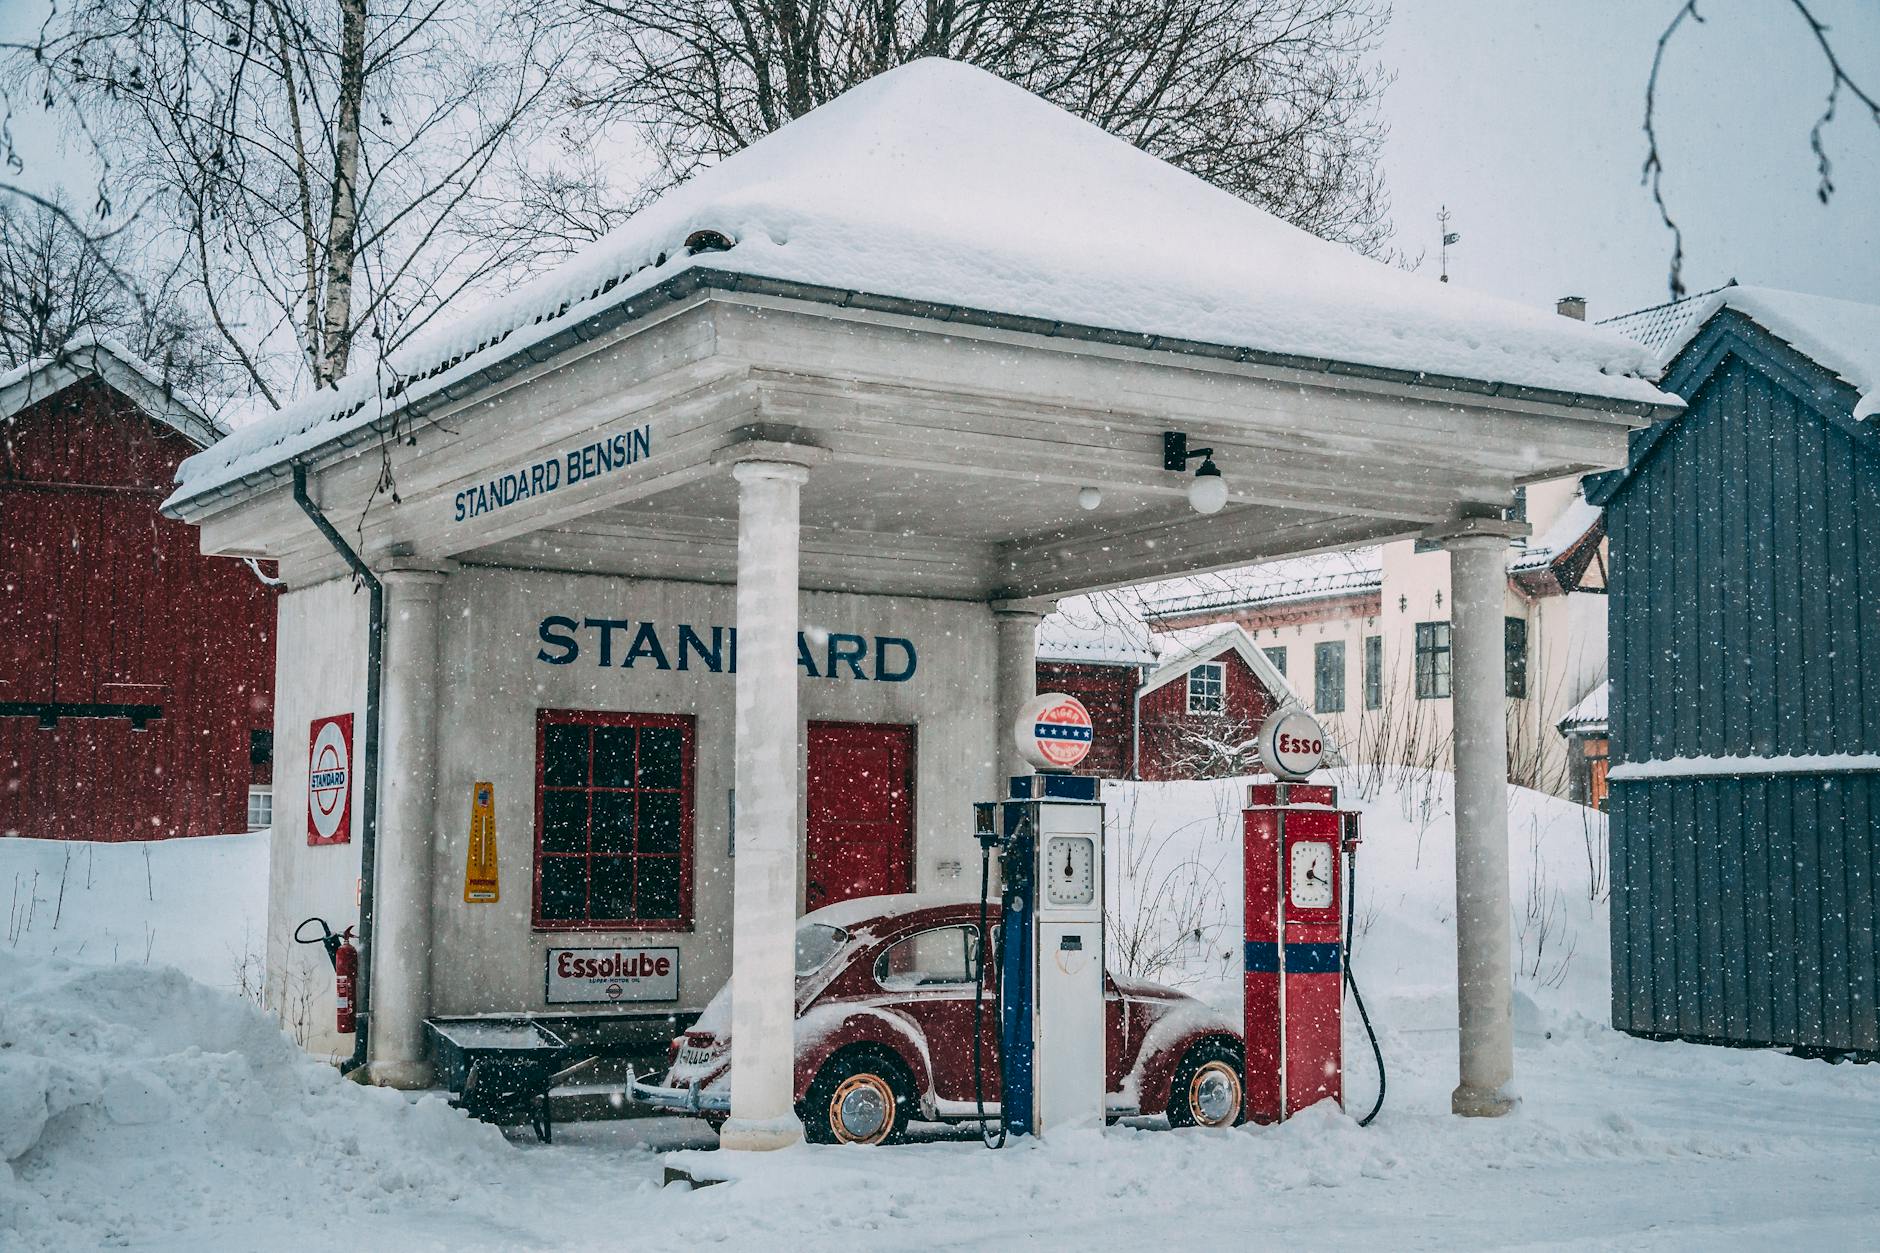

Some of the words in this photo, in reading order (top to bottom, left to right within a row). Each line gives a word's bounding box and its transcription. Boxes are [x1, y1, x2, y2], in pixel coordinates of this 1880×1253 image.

[455, 458, 560, 522] STANDARD
[567, 424, 650, 486] BENSIN
[537, 615, 917, 682] STANARD
[311, 771, 345, 788] STANDARD
[557, 951, 670, 978] Essolube
